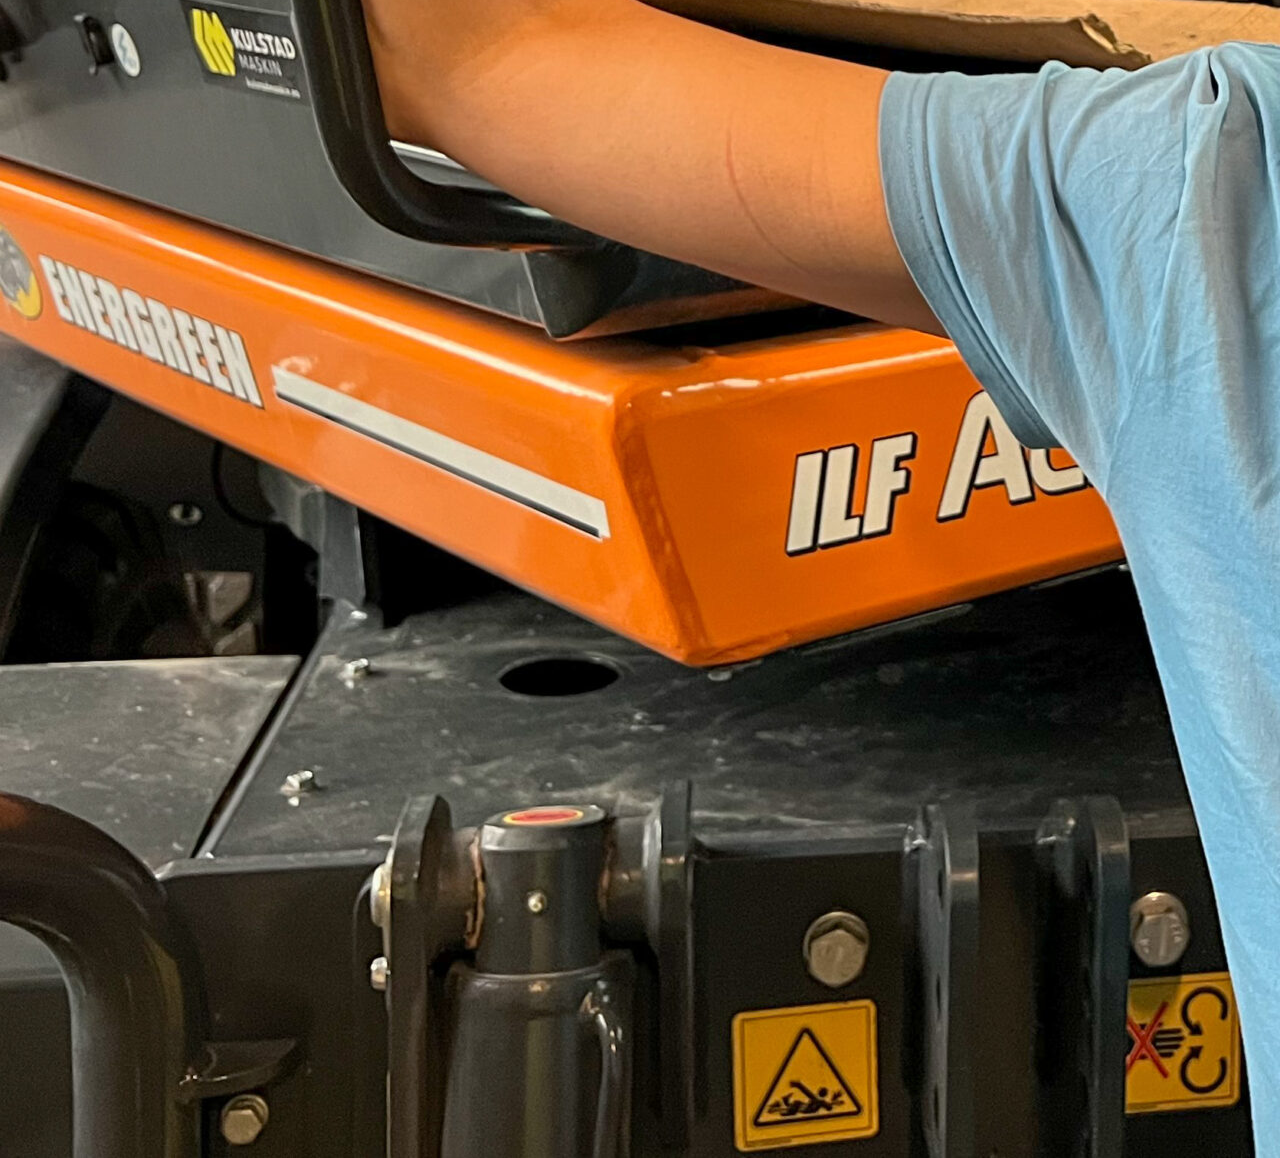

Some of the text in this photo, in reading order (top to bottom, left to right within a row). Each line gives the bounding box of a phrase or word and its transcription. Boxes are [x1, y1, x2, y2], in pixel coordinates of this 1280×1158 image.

[230, 27, 297, 60] KULSTAD
[238, 52, 283, 78] MASKIN
[38, 253, 266, 410] ENERGREEN
[785, 431, 918, 557] ILF
